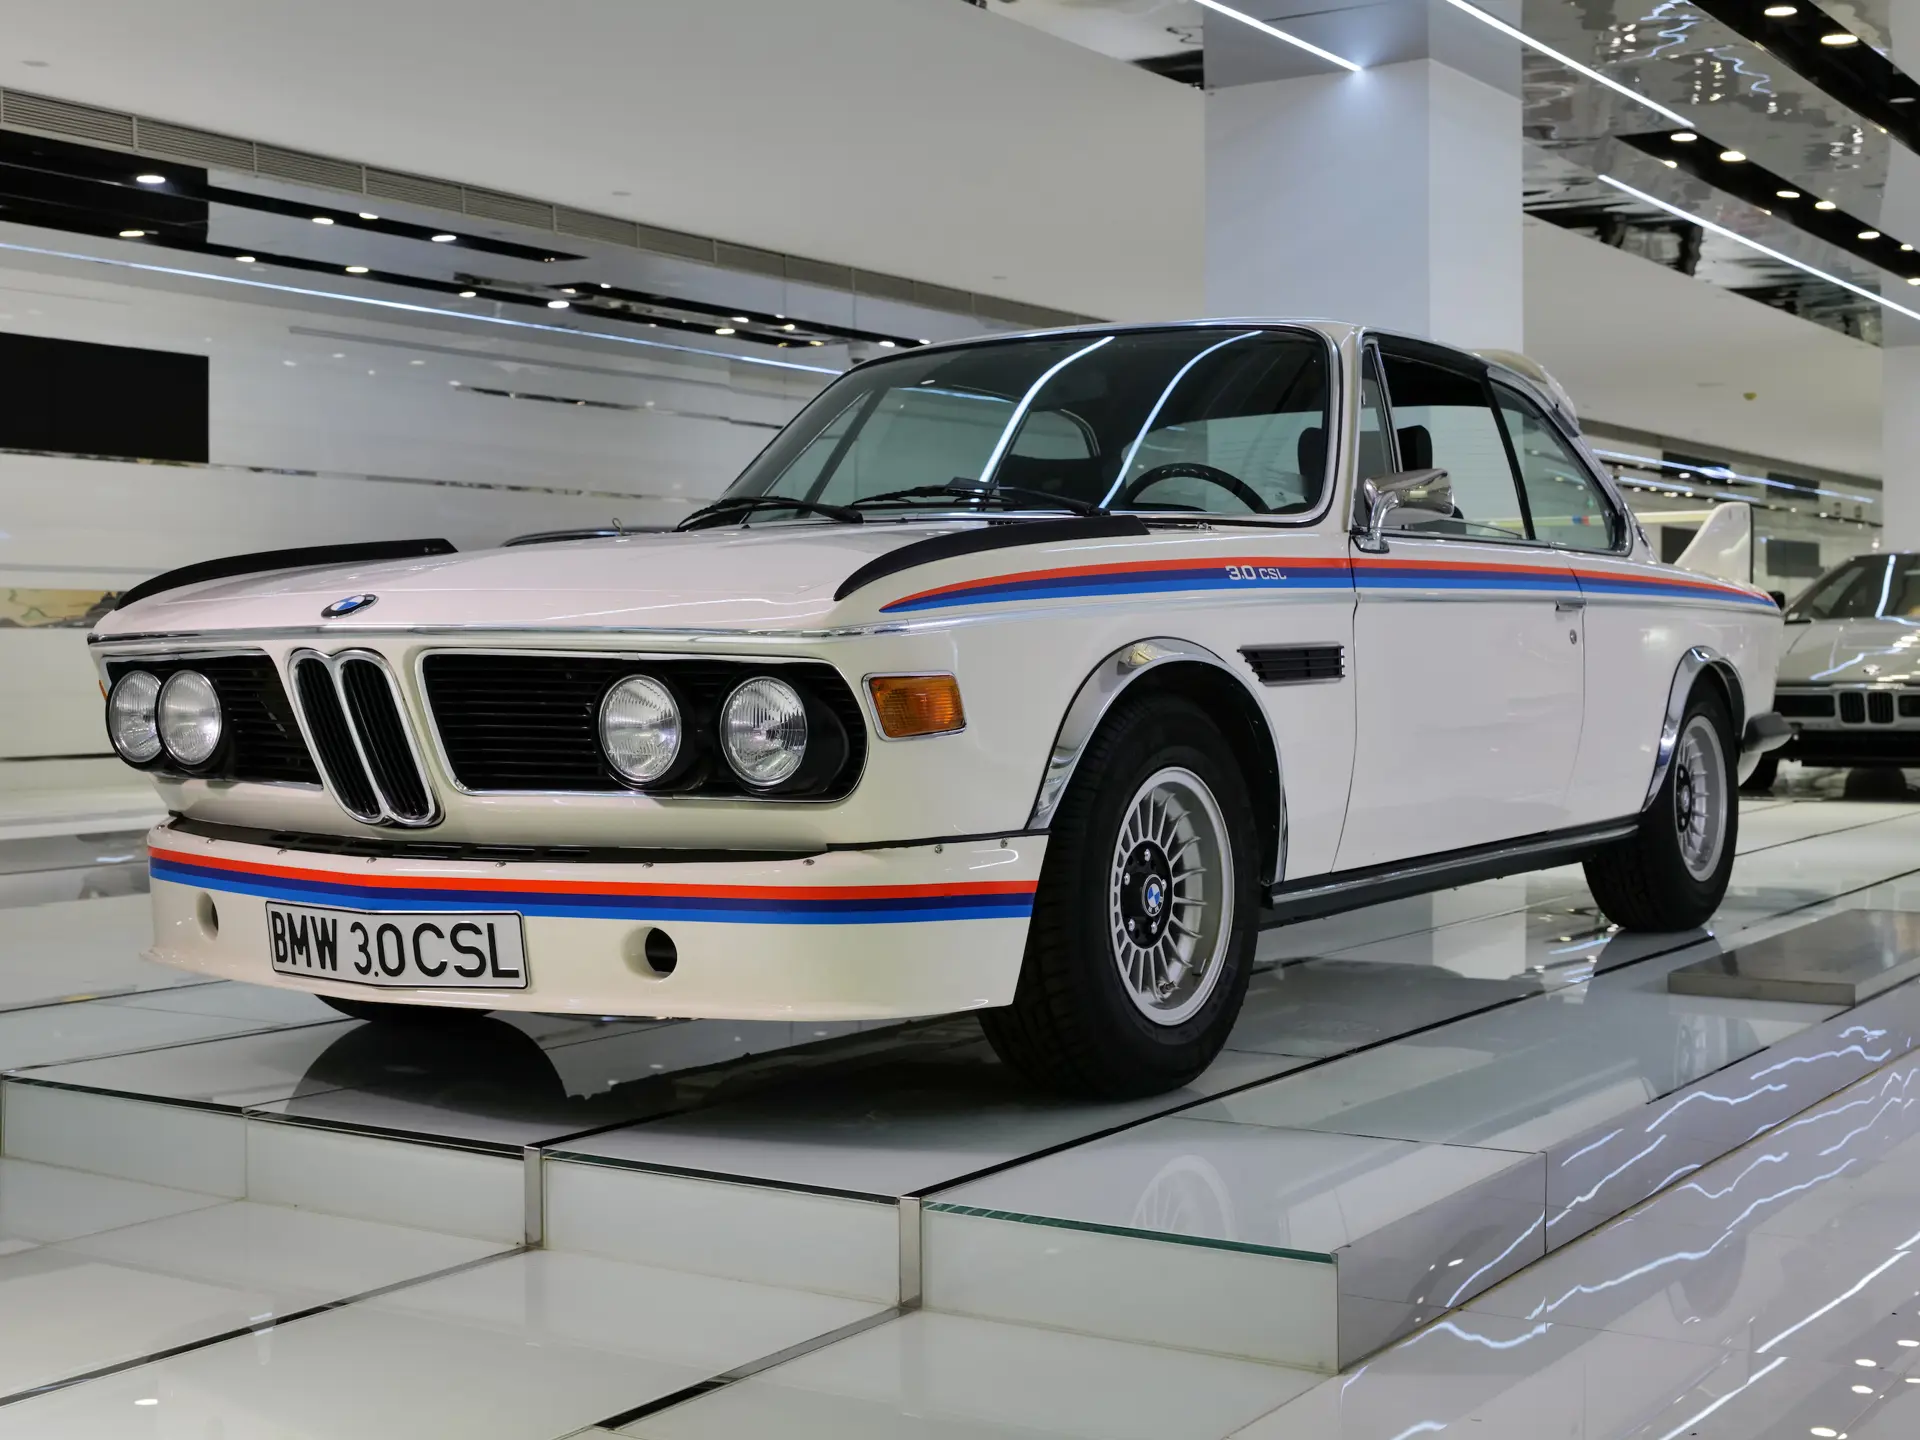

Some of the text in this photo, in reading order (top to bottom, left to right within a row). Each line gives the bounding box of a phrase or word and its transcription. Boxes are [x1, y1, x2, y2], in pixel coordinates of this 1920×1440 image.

[1225, 565, 1287, 580] 3.0 CSL
[271, 910, 337, 971] BMW
